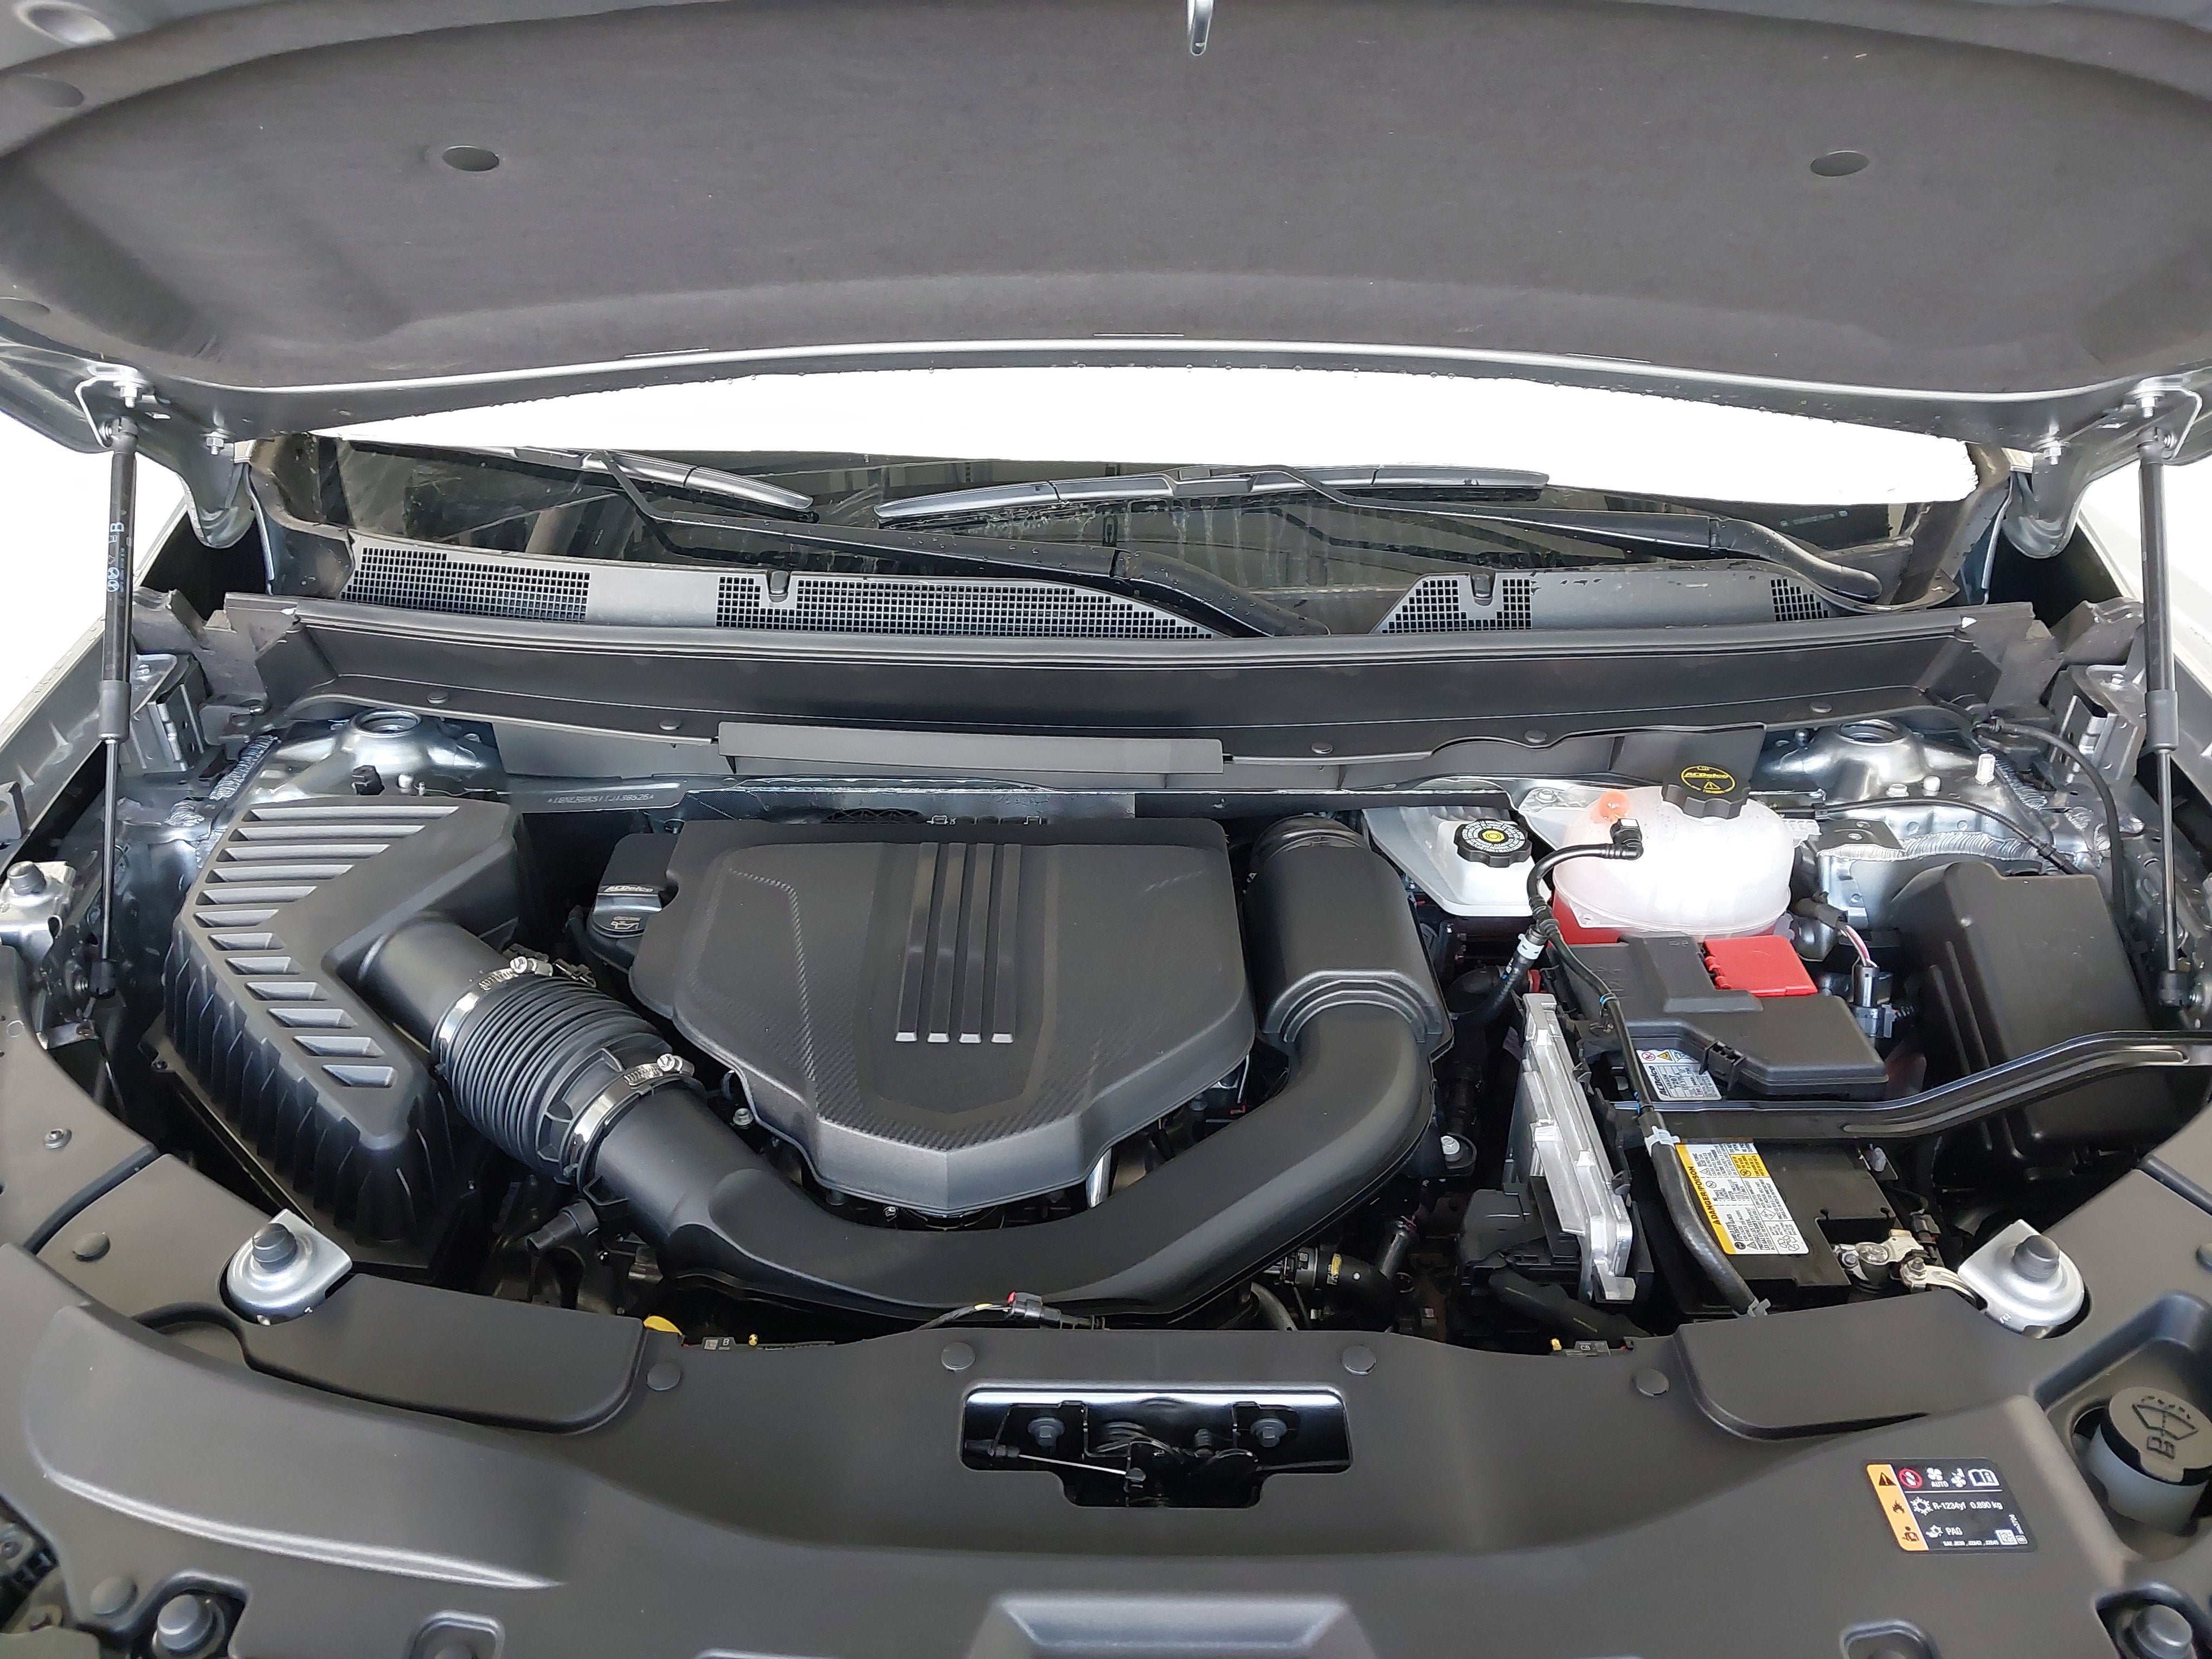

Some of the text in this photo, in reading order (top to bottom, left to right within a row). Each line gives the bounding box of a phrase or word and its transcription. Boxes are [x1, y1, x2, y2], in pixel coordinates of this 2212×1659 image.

[1648, 1065, 1669, 1096] ACDelco
[1687, 1166, 1719, 1219] DANGER/POISON
[1991, 1501, 2003, 1510] kg
[1945, 1527, 1963, 1535] PAG
